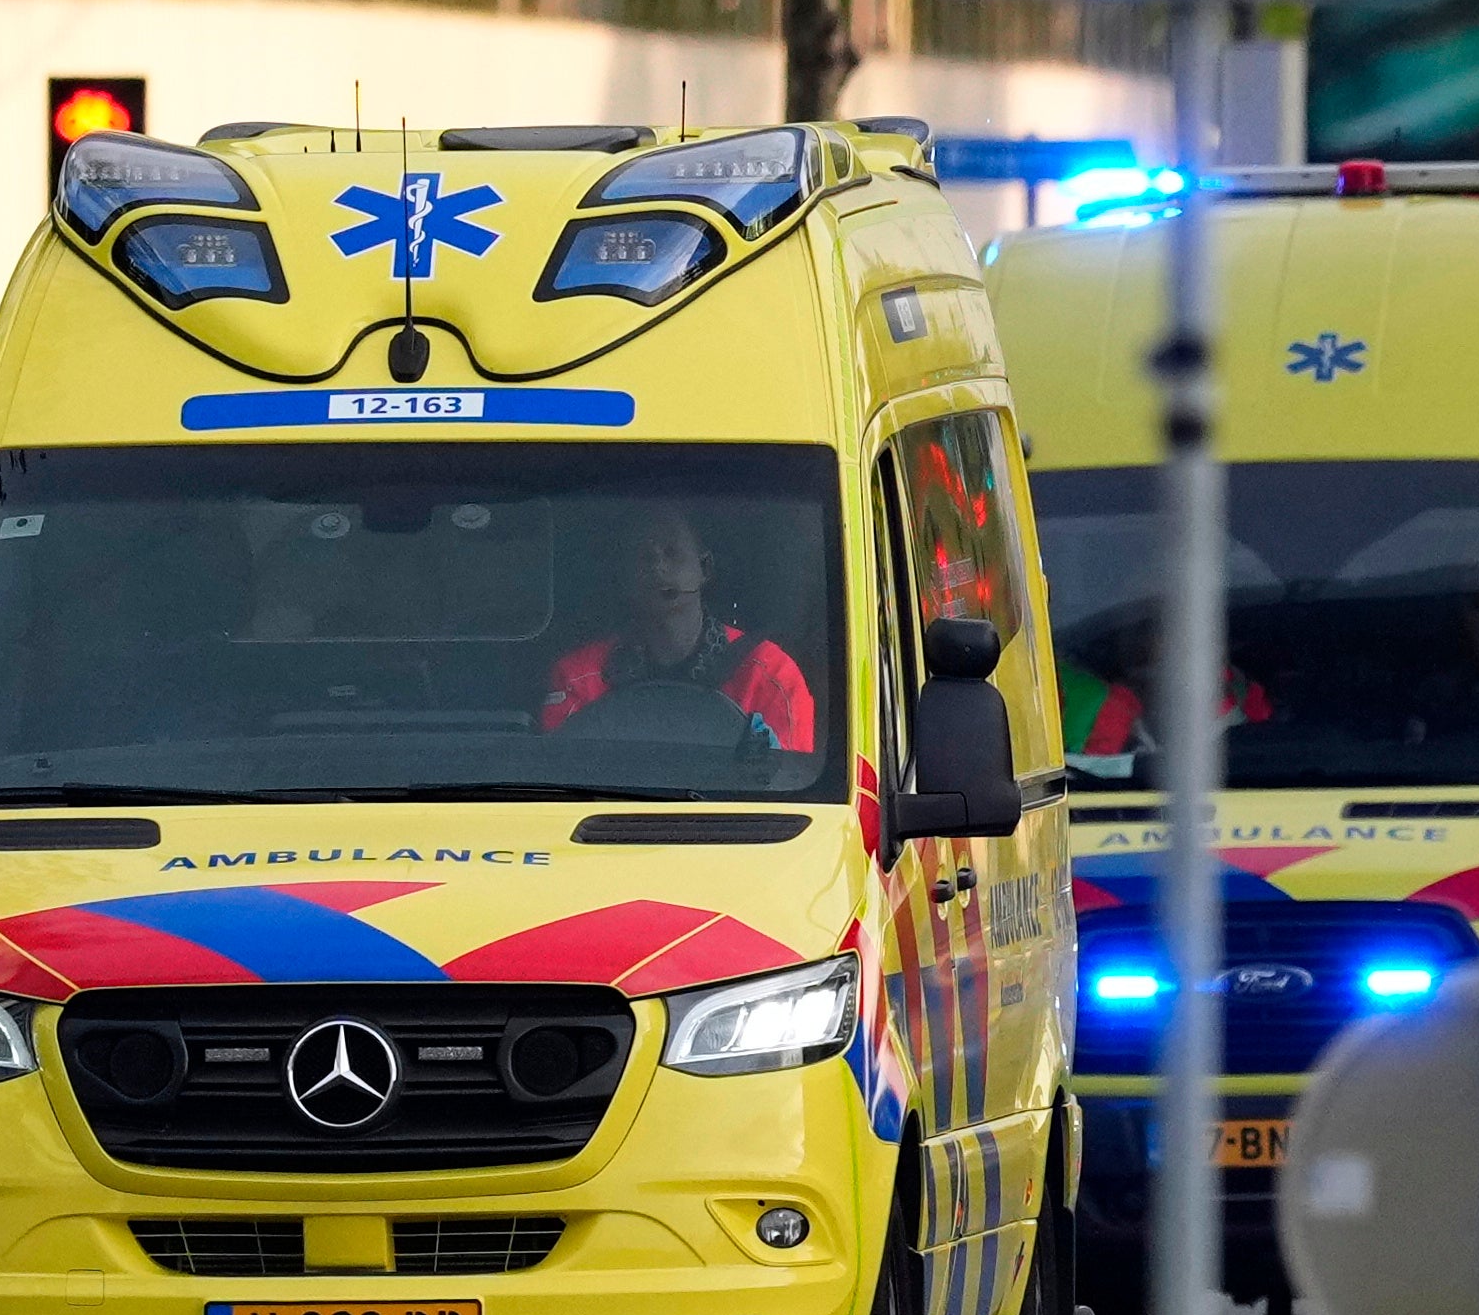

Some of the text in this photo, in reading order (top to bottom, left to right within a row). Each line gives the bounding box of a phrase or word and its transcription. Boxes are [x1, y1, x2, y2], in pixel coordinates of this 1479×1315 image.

[352, 397, 462, 414] 12-163
[1098, 824, 1448, 848] AMULANCE
[159, 848, 551, 871] AMBULANCE
